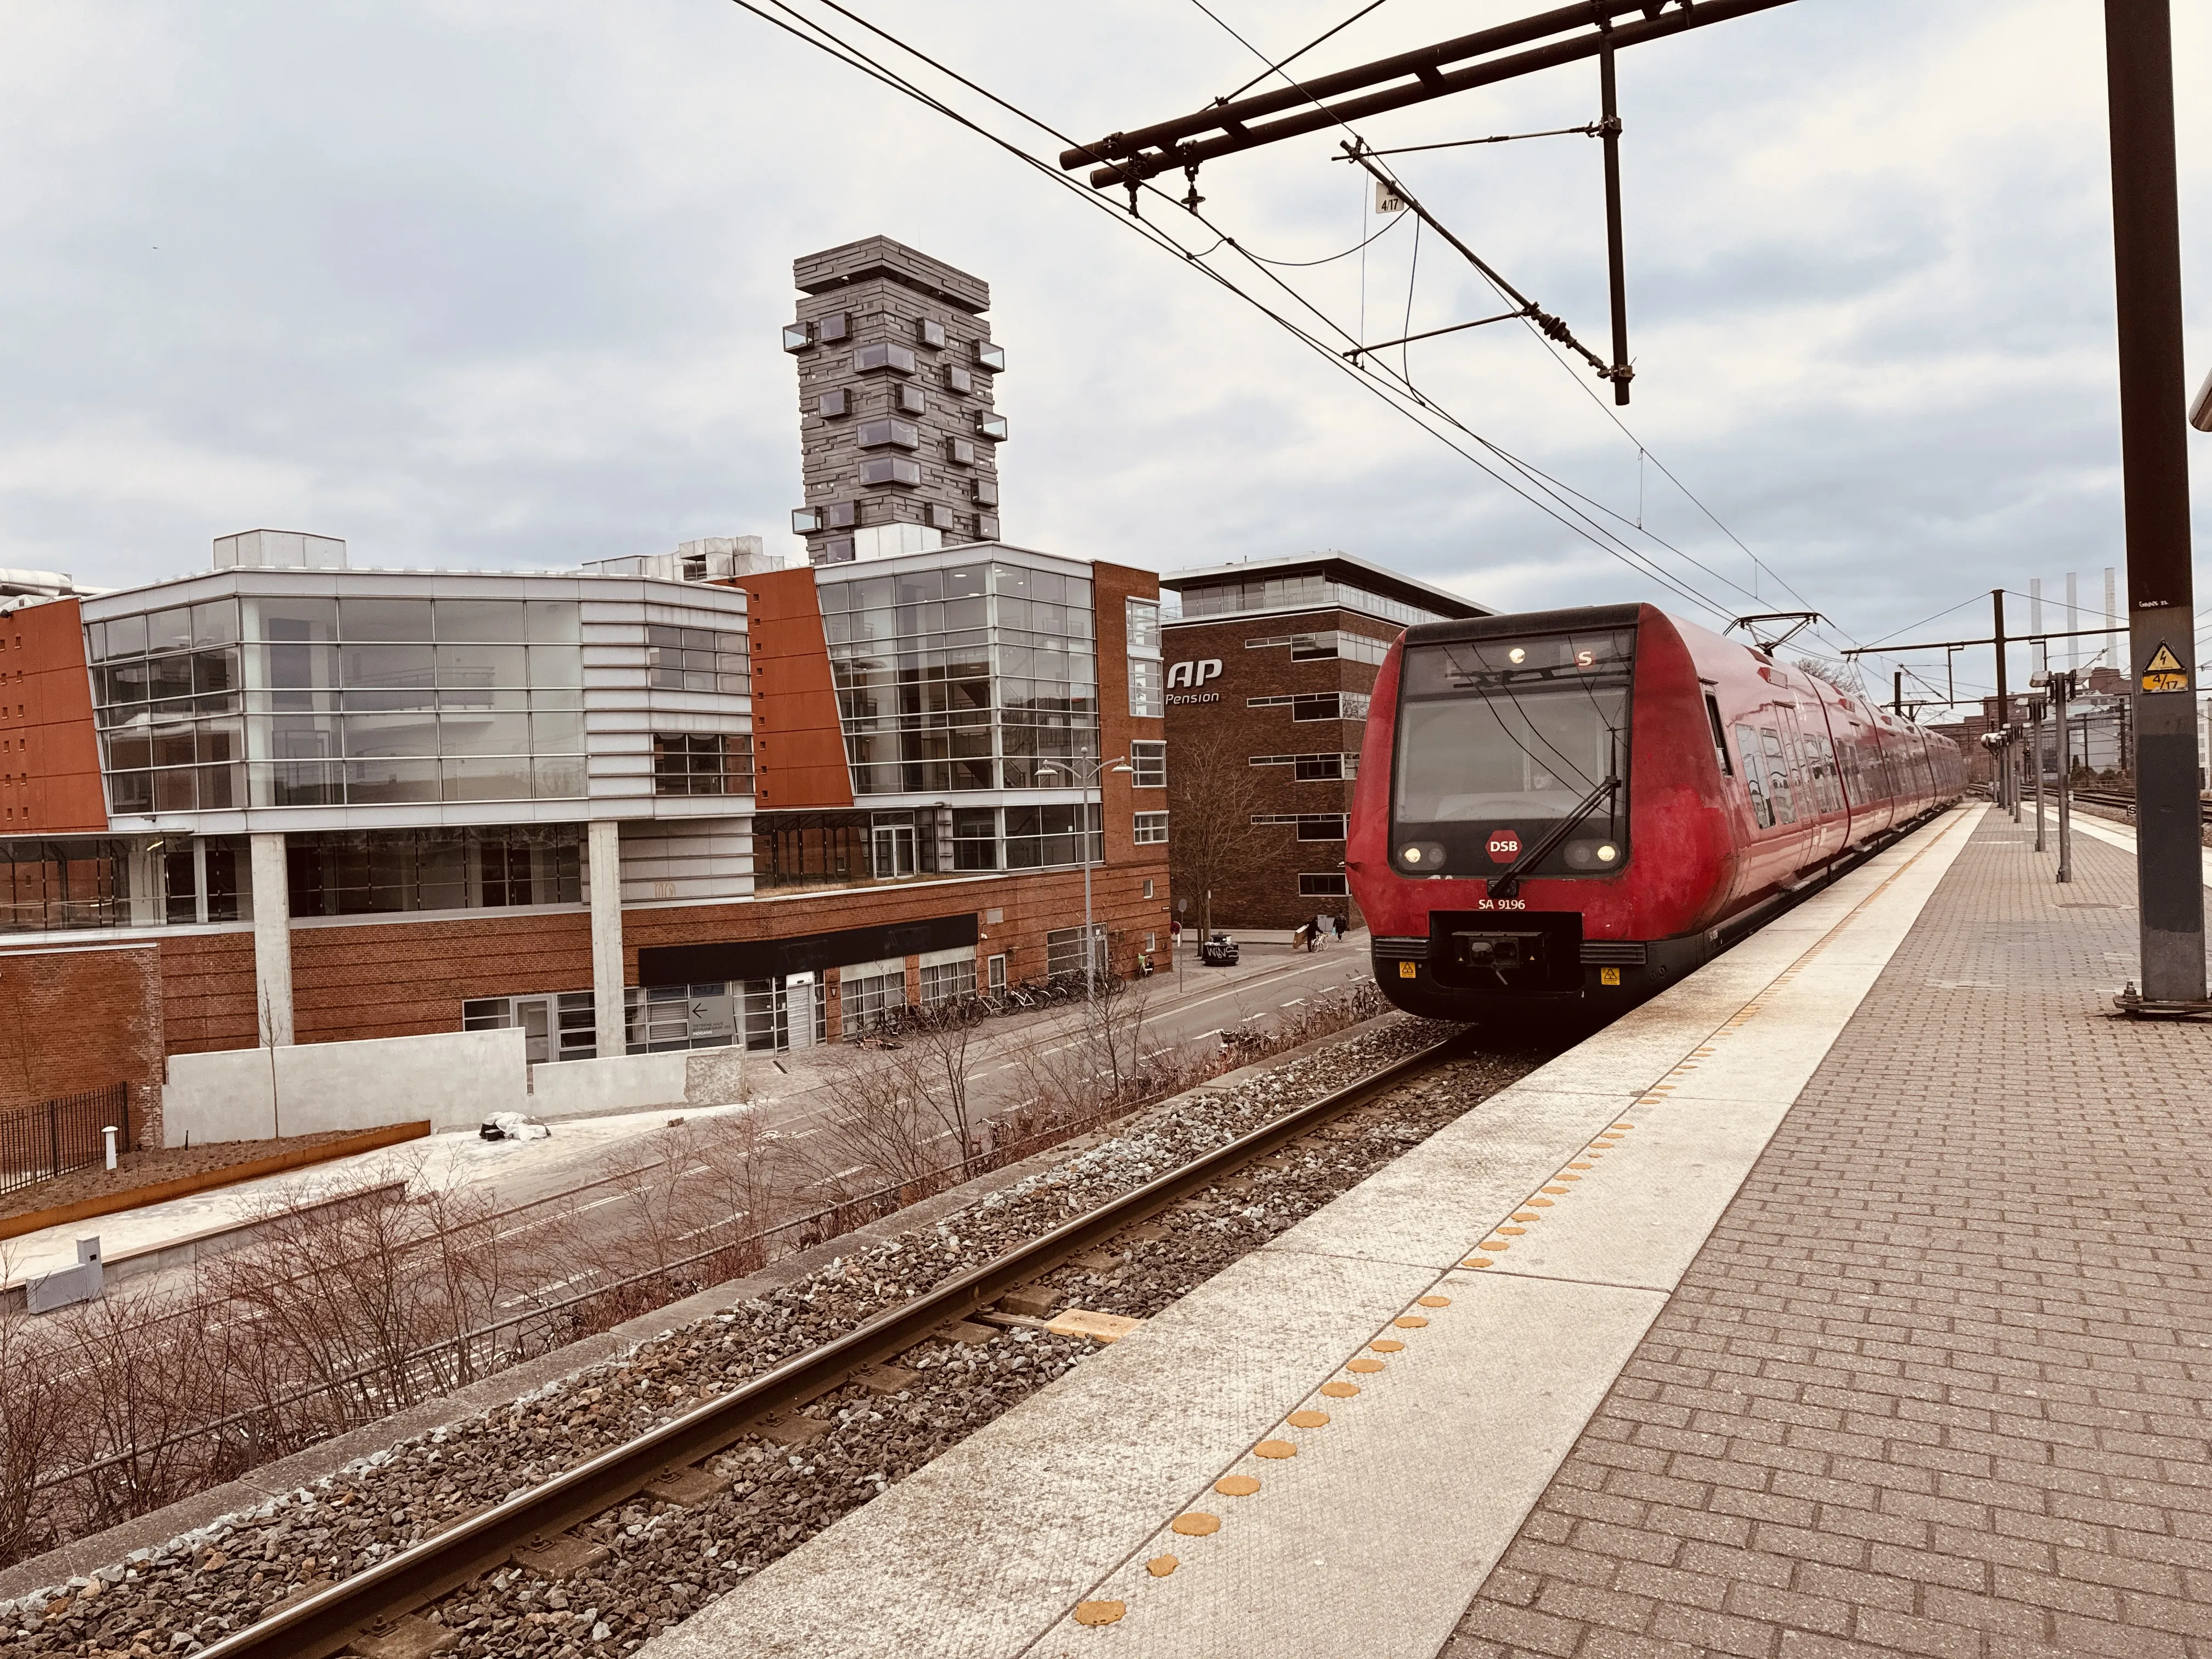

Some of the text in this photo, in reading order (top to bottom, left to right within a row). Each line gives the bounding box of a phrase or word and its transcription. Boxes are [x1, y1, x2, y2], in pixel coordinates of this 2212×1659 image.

[1381, 199, 1398, 211] 4/17
[1578, 651, 1592, 666] S
[1167, 659, 1222, 689] AP
[2153, 674, 2178, 690] 4/17
[1166, 693, 1219, 706] Pension
[1490, 841, 1518, 852] DSB
[1479, 899, 1525, 910] SA 9196
